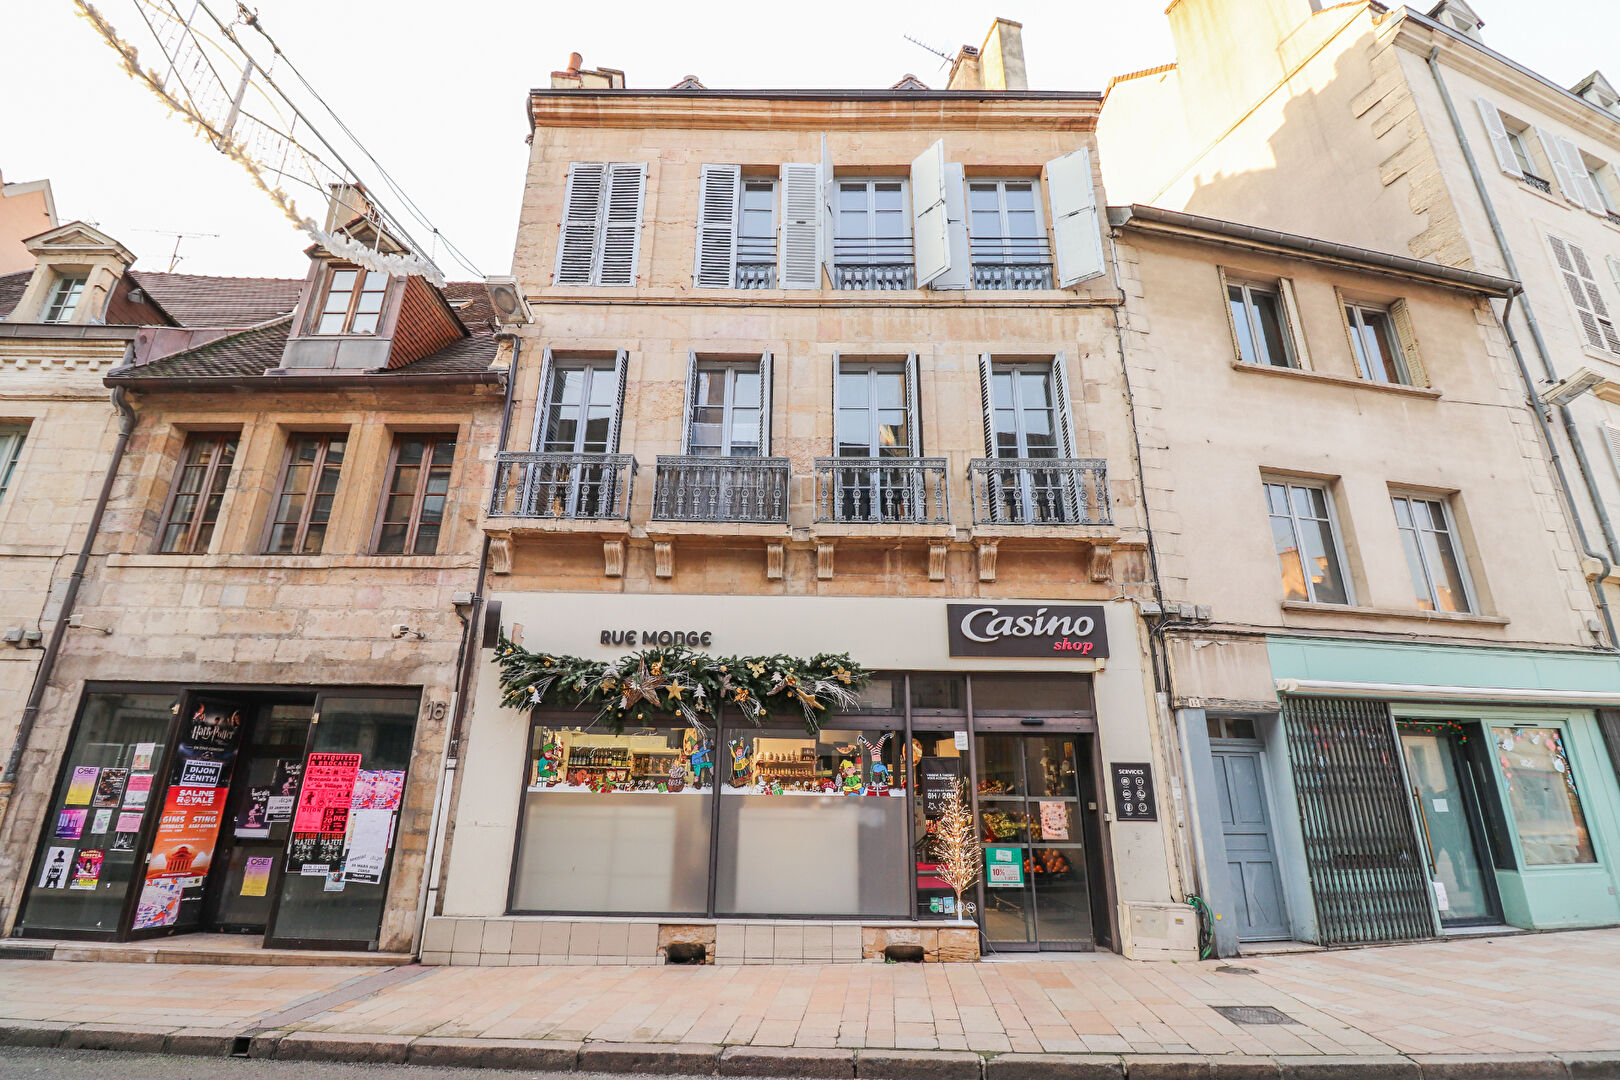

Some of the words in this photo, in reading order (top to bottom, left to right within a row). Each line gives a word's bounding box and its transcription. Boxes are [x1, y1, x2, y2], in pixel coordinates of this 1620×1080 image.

[961, 607, 1095, 643] Casino
[600, 629, 637, 646] RUE
[642, 630, 712, 647] MONGE
[1053, 637, 1094, 655] shop
[424, 700, 447, 721] 16
[183, 773, 216, 782] ZÉNITH
[189, 766, 216, 775] DIJON
